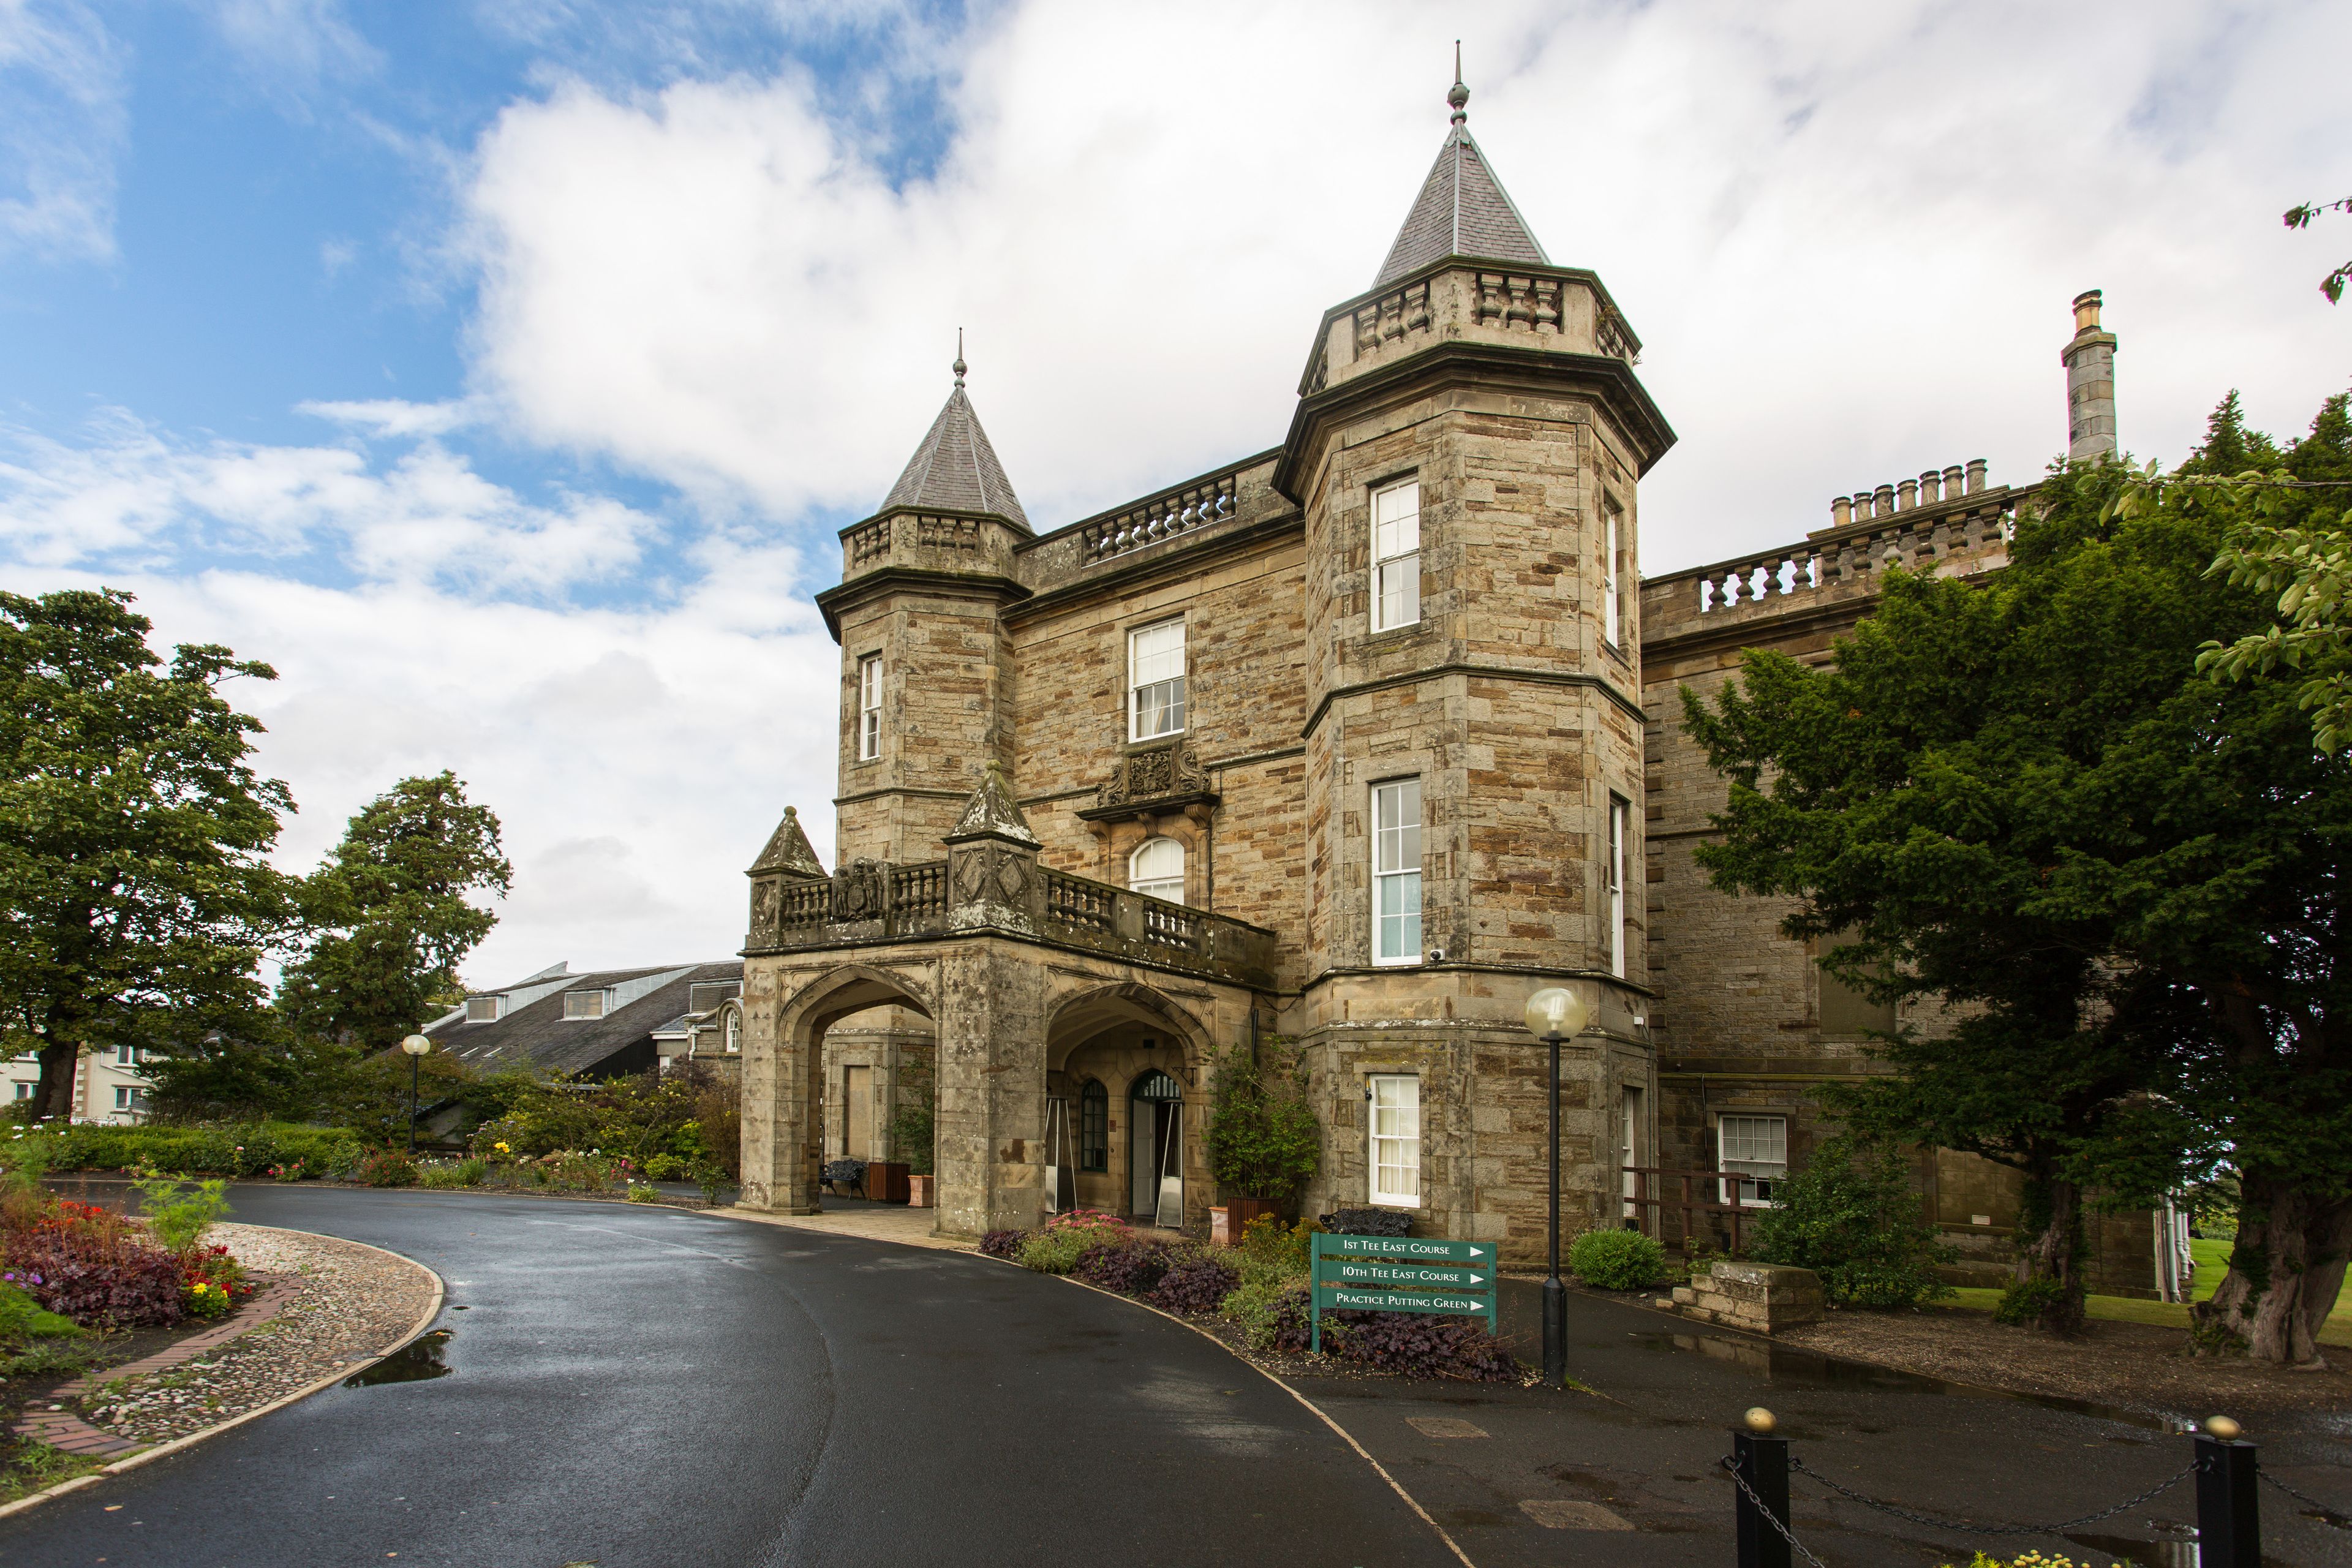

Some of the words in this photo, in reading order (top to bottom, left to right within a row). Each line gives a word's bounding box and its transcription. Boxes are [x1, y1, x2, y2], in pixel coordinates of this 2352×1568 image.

[1361, 1240, 1379, 1251] TEE
[1382, 1242, 1406, 1252] EAST
[1410, 1243, 1450, 1254] COURSE
[1343, 1266, 1367, 1277] 10TH
[1370, 1267, 1389, 1278] TEE
[1392, 1268, 1416, 1280] EAST
[1420, 1270, 1460, 1282] COURSE
[1336, 1292, 1384, 1304] PRACTICE
[1388, 1295, 1430, 1307] PUTTING
[1433, 1298, 1468, 1308] GREEN
